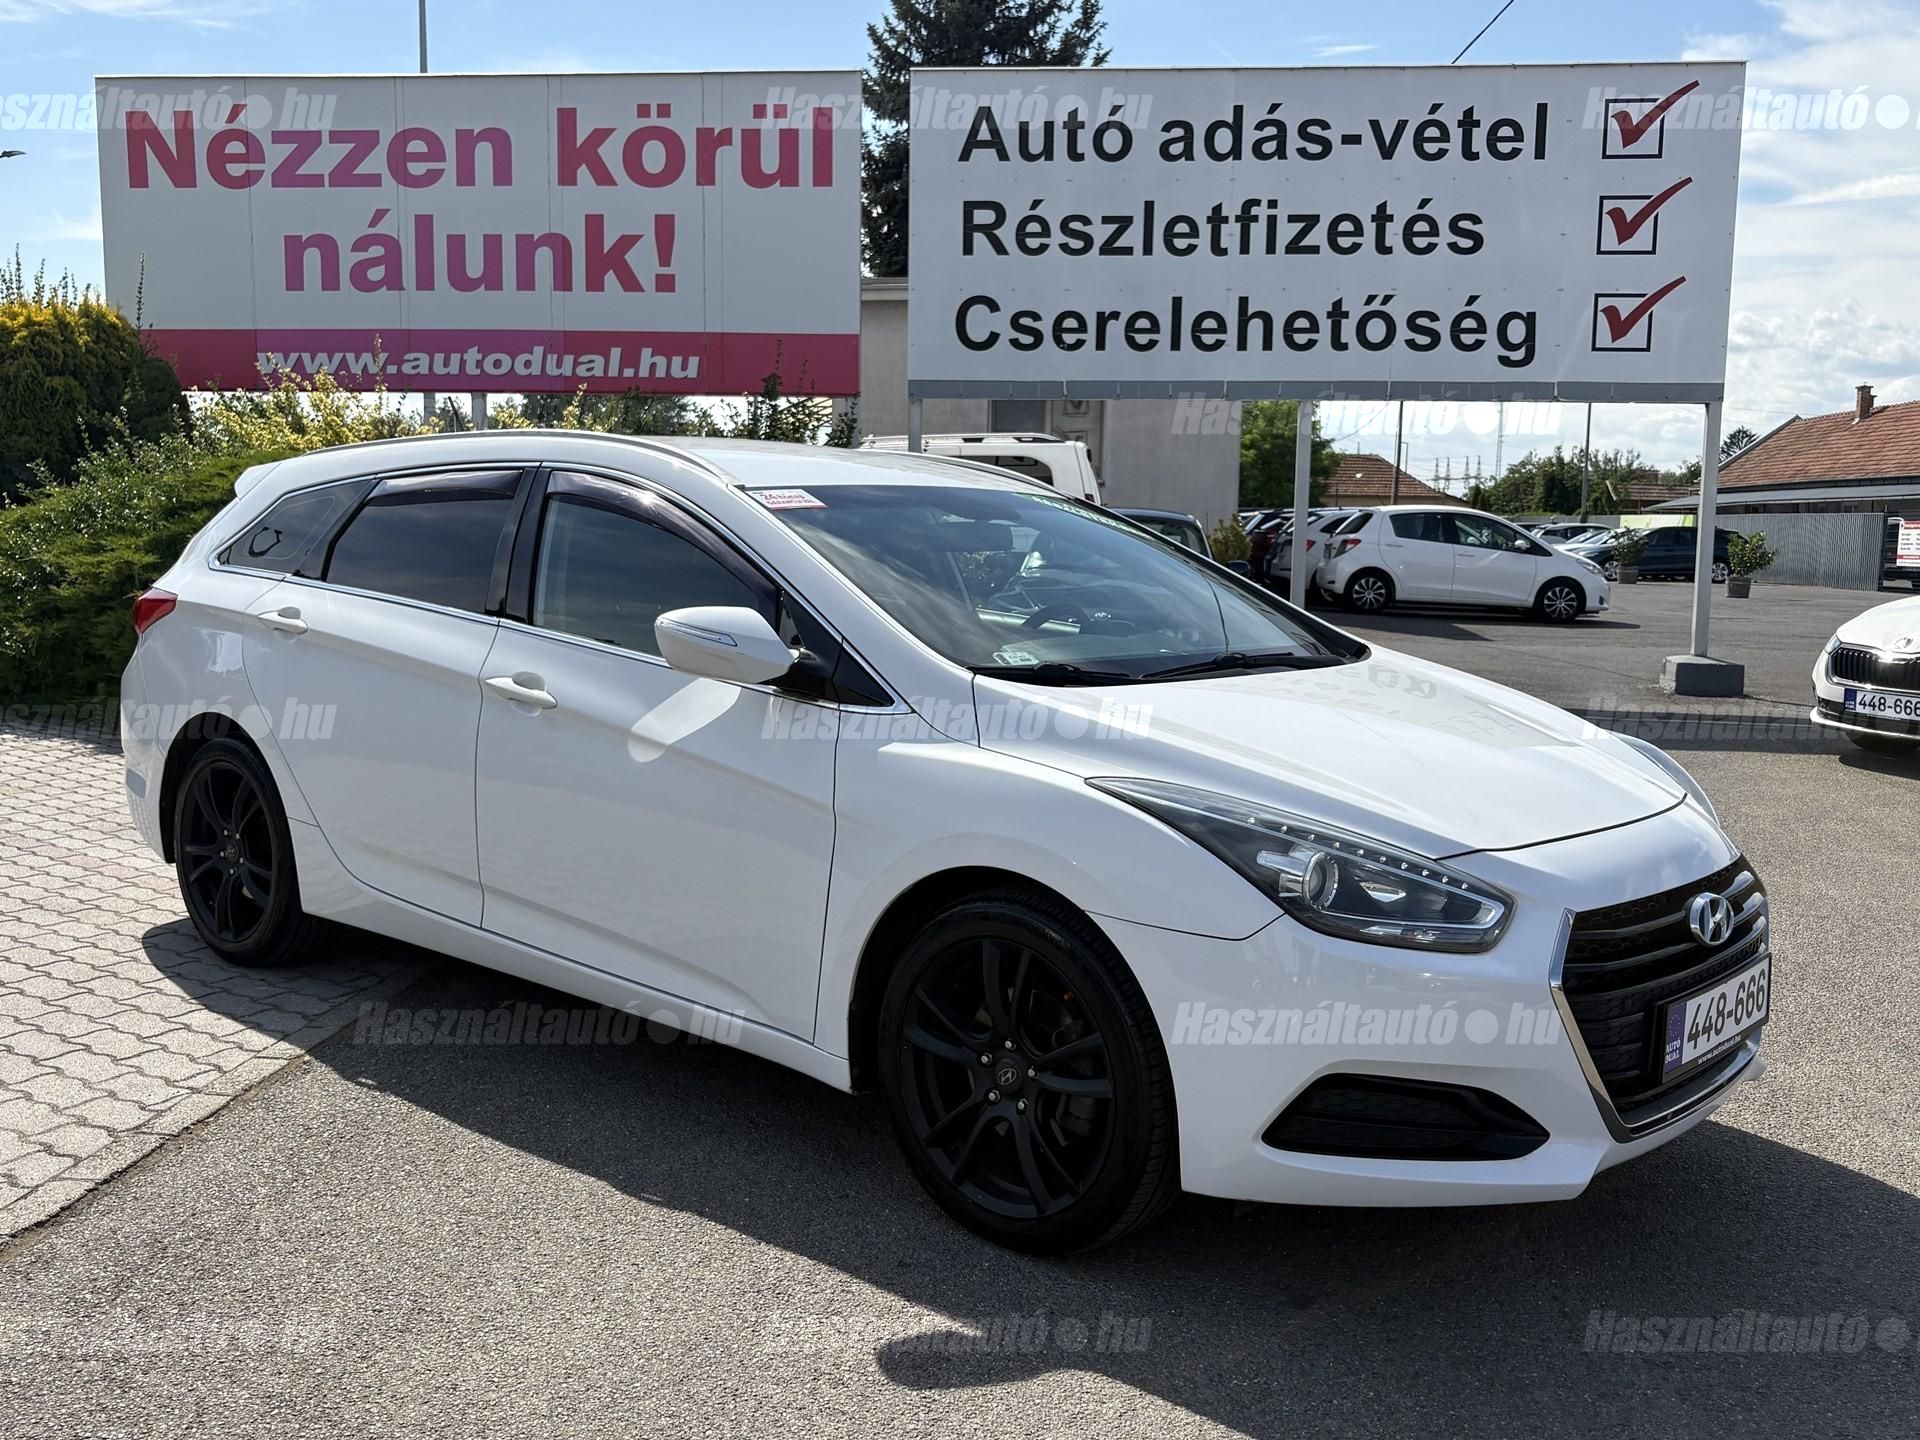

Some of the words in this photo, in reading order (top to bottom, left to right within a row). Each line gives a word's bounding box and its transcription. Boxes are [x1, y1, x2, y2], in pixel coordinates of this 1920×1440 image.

[126, 103, 512, 190] Nézzen
[557, 103, 834, 189] körül
[957, 103, 1134, 163] Autó
[1158, 101, 1549, 163] adás-vétel
[284, 208, 677, 293] nálunk!
[962, 196, 1485, 257] Részletfizetés
[256, 345, 700, 380] www.autodual.hu
[954, 293, 1538, 369] Cserelehetőség
[1687, 968, 1765, 1050] 448-666
